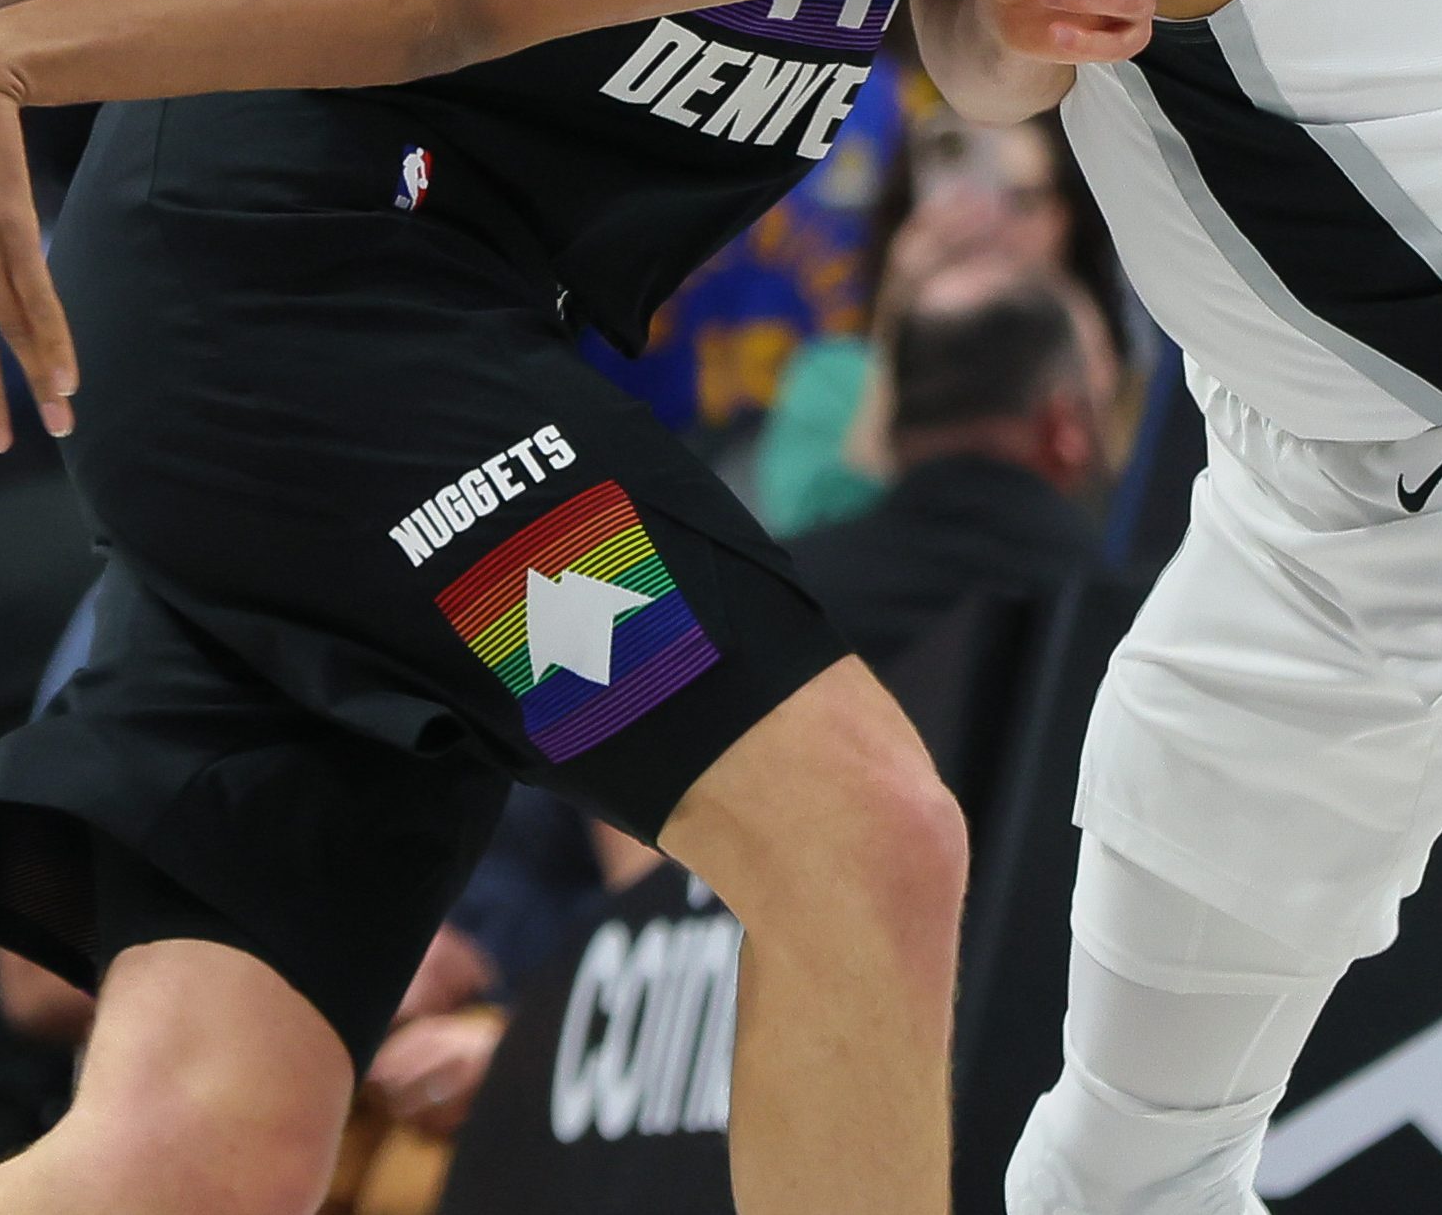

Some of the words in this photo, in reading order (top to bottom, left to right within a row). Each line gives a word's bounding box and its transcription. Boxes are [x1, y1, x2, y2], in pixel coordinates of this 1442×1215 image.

[599, 16, 872, 160] DENVE
[388, 424, 577, 568] NUGGETS
[550, 873, 742, 1143] coin
